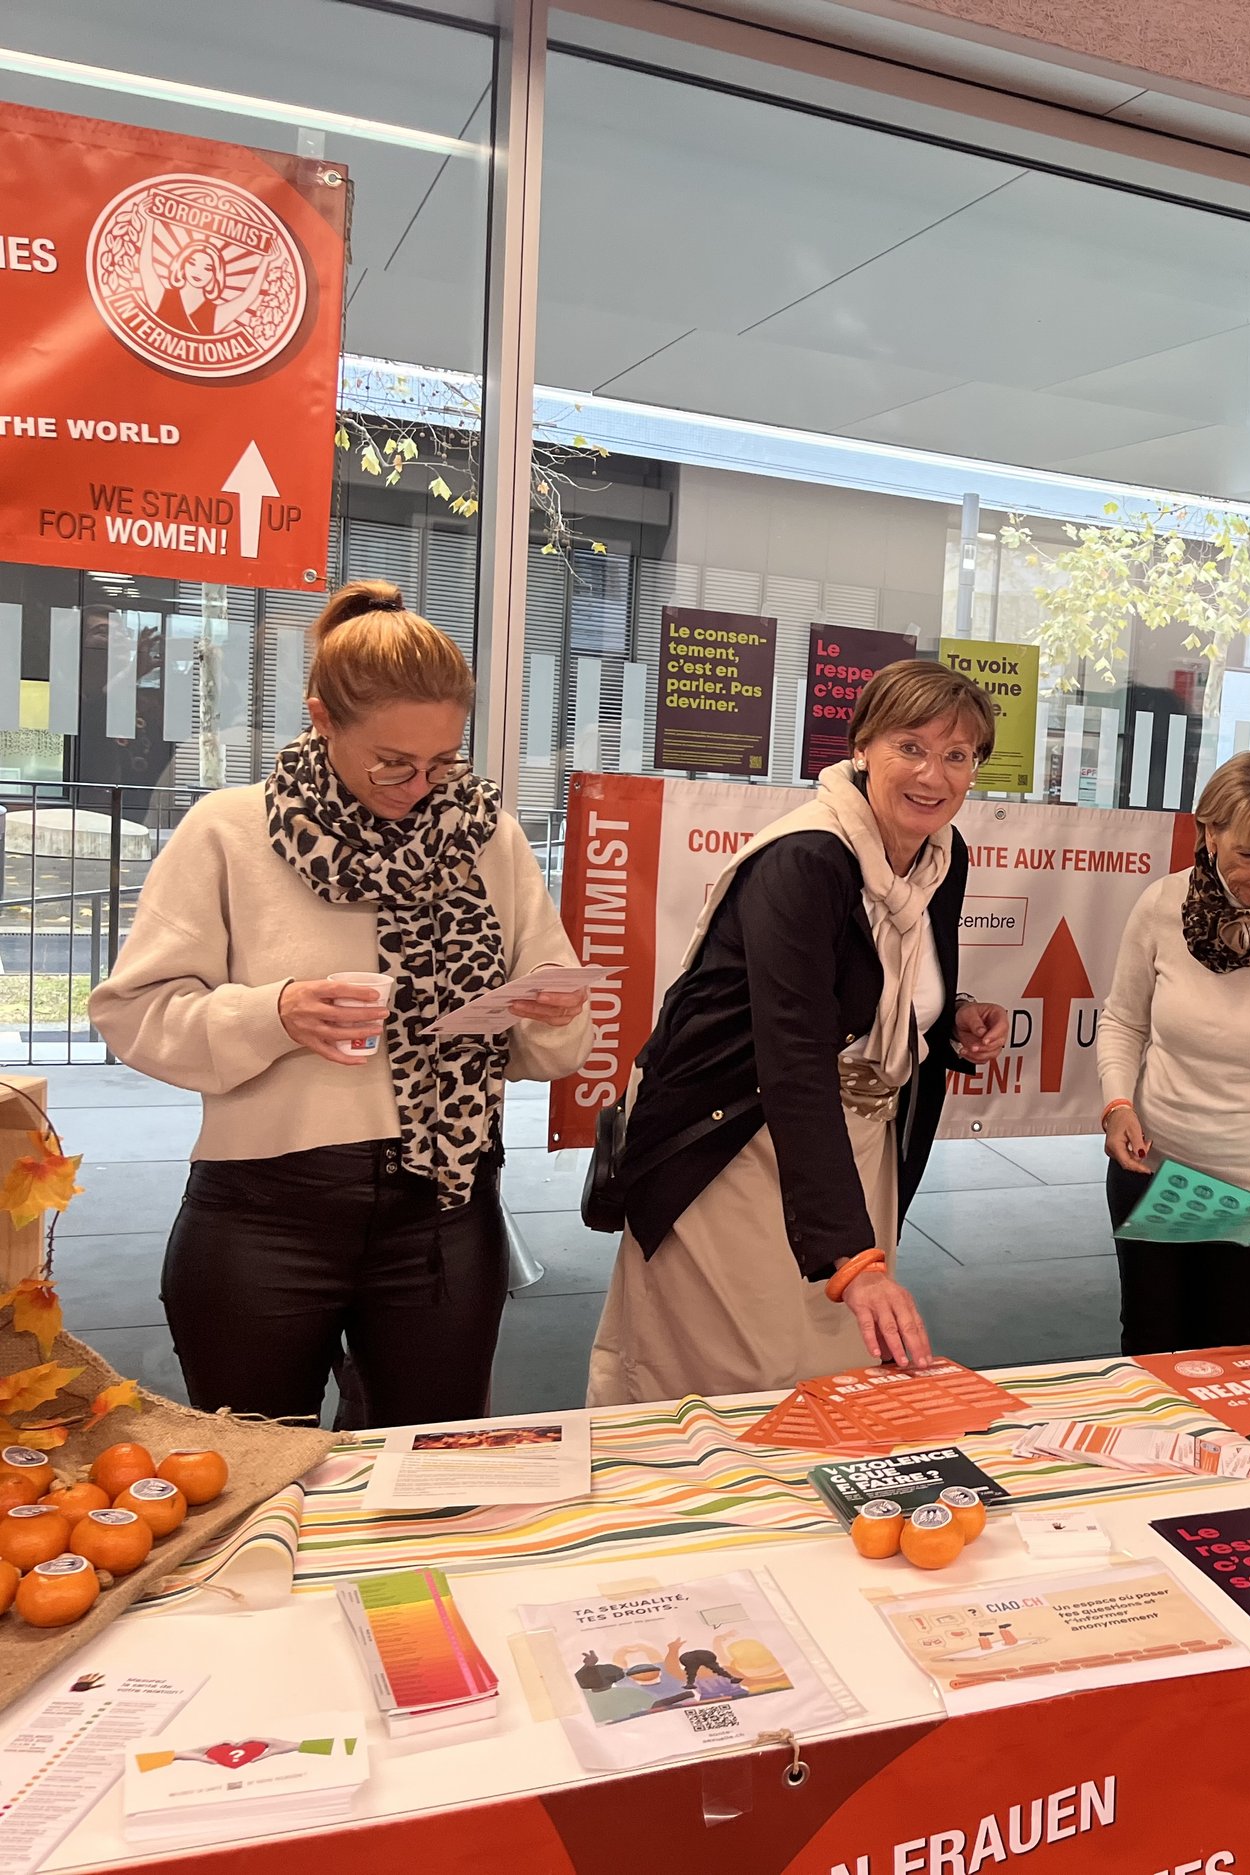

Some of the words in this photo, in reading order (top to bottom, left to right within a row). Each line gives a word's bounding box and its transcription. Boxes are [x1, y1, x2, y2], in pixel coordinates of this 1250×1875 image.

[152, 196, 273, 251] SOROPTIMIST
[0, 236, 58, 273] ES
[113, 297, 257, 364] INTERNATIONAL
[67, 419, 181, 446] WORLD
[89, 483, 133, 515] WE
[141, 489, 233, 526] STAND
[267, 503, 302, 532] UP
[39, 509, 97, 541] FOR
[105, 515, 228, 555] WOMEN!
[669, 623, 691, 638] Le
[694, 628, 767, 646] consen-
[668, 640, 740, 663] tement,
[816, 639, 841, 658] Le
[715, 664, 738, 678] en
[947, 653, 972, 671] Ta
[976, 656, 1019, 675] voix
[666, 677, 726, 694] parler.
[730, 681, 763, 698] Pas
[984, 680, 1022, 697] une
[665, 693, 739, 713] deviner.
[1014, 847, 1055, 871] AUX
[1061, 848, 1151, 875] FEMMES
[1227, 1397, 1247, 1408] de
[838, 1449, 960, 1475] VIOLENCE
[848, 1467, 901, 1482] QUE
[856, 1473, 926, 1491] FAIRE
[1176, 1528, 1220, 1542] Le
[573, 1607, 595, 1617] TA
[598, 1593, 690, 1613] SEXUALITÉ,
[986, 1596, 1044, 1614] CIAO.CH
[1052, 1604, 1071, 1613] Un
[1073, 1597, 1117, 1610] espace
[1118, 1593, 1134, 1603] où
[1135, 1588, 1170, 1600] poser
[1058, 1610, 1079, 1619] tes
[1081, 1600, 1143, 1618] questions
[1143, 1597, 1157, 1606] et
[576, 1613, 607, 1624] TES
[612, 1603, 678, 1619] DROITS.
[1070, 1612, 1160, 1633] anonymement
[893, 1775, 1118, 1875] FRAUEN
